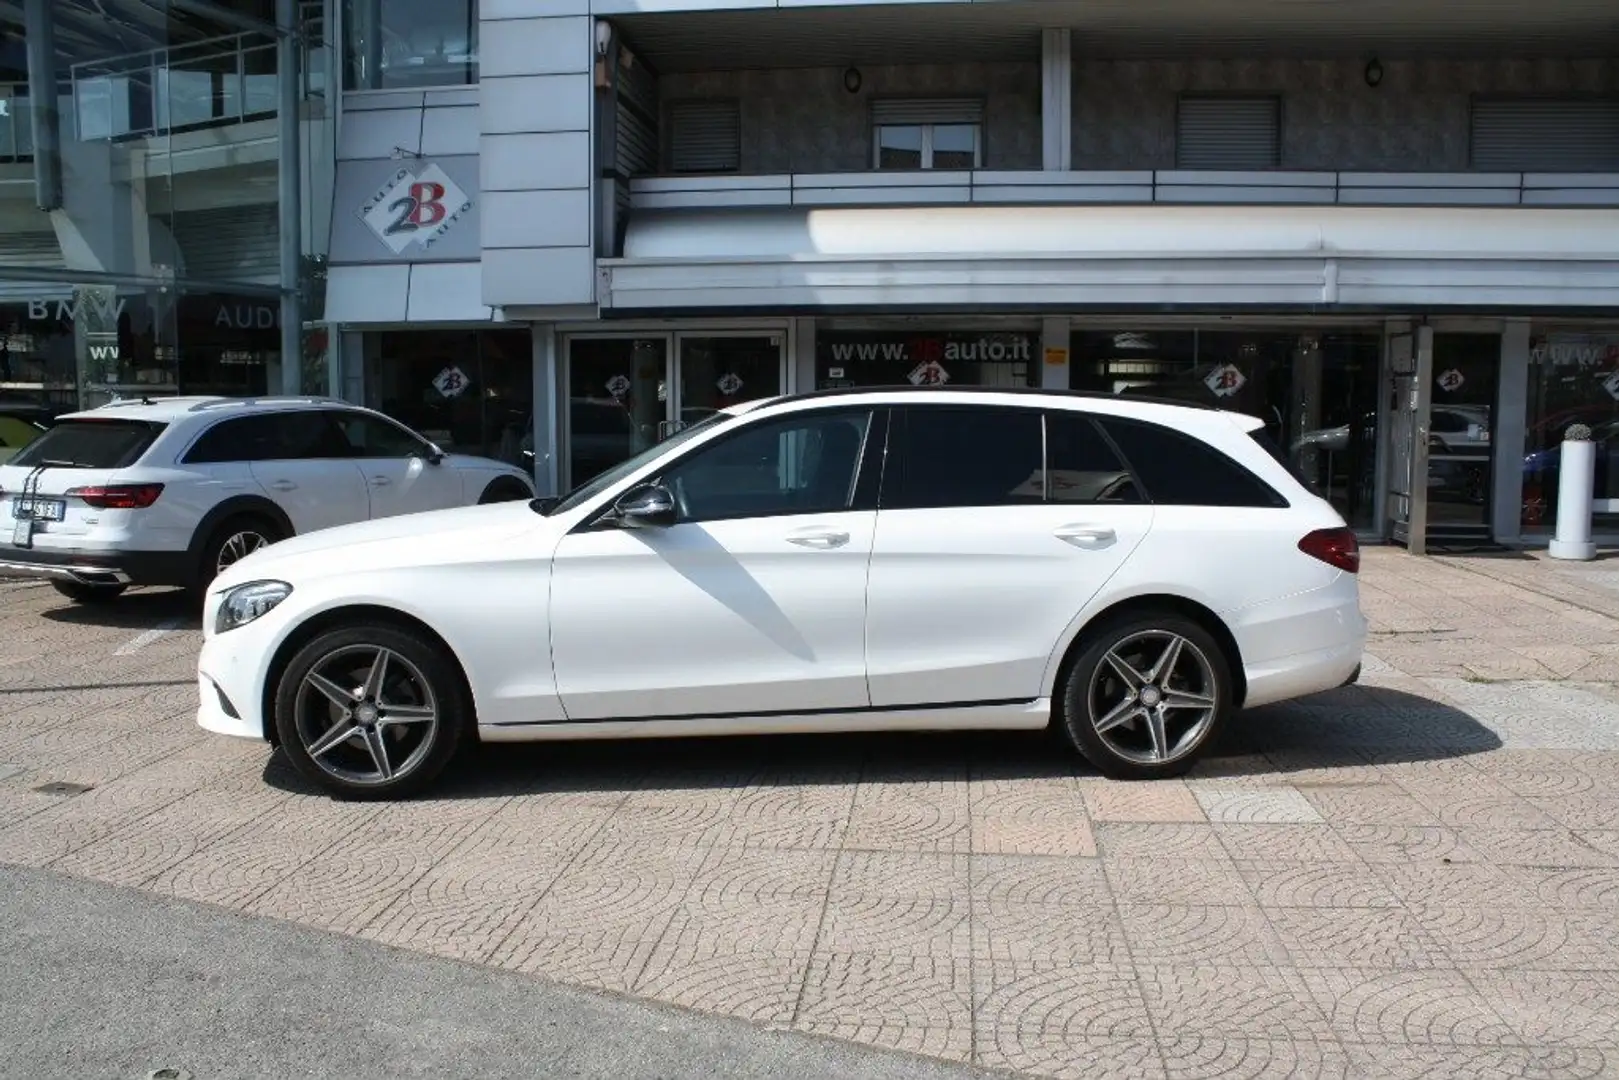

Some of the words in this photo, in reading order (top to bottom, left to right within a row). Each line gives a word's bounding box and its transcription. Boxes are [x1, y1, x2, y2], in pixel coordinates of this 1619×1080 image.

[363, 169, 408, 214] AUTO
[383, 181, 447, 236] 2B
[424, 201, 473, 249] AUTO
[27, 297, 126, 322] BMW
